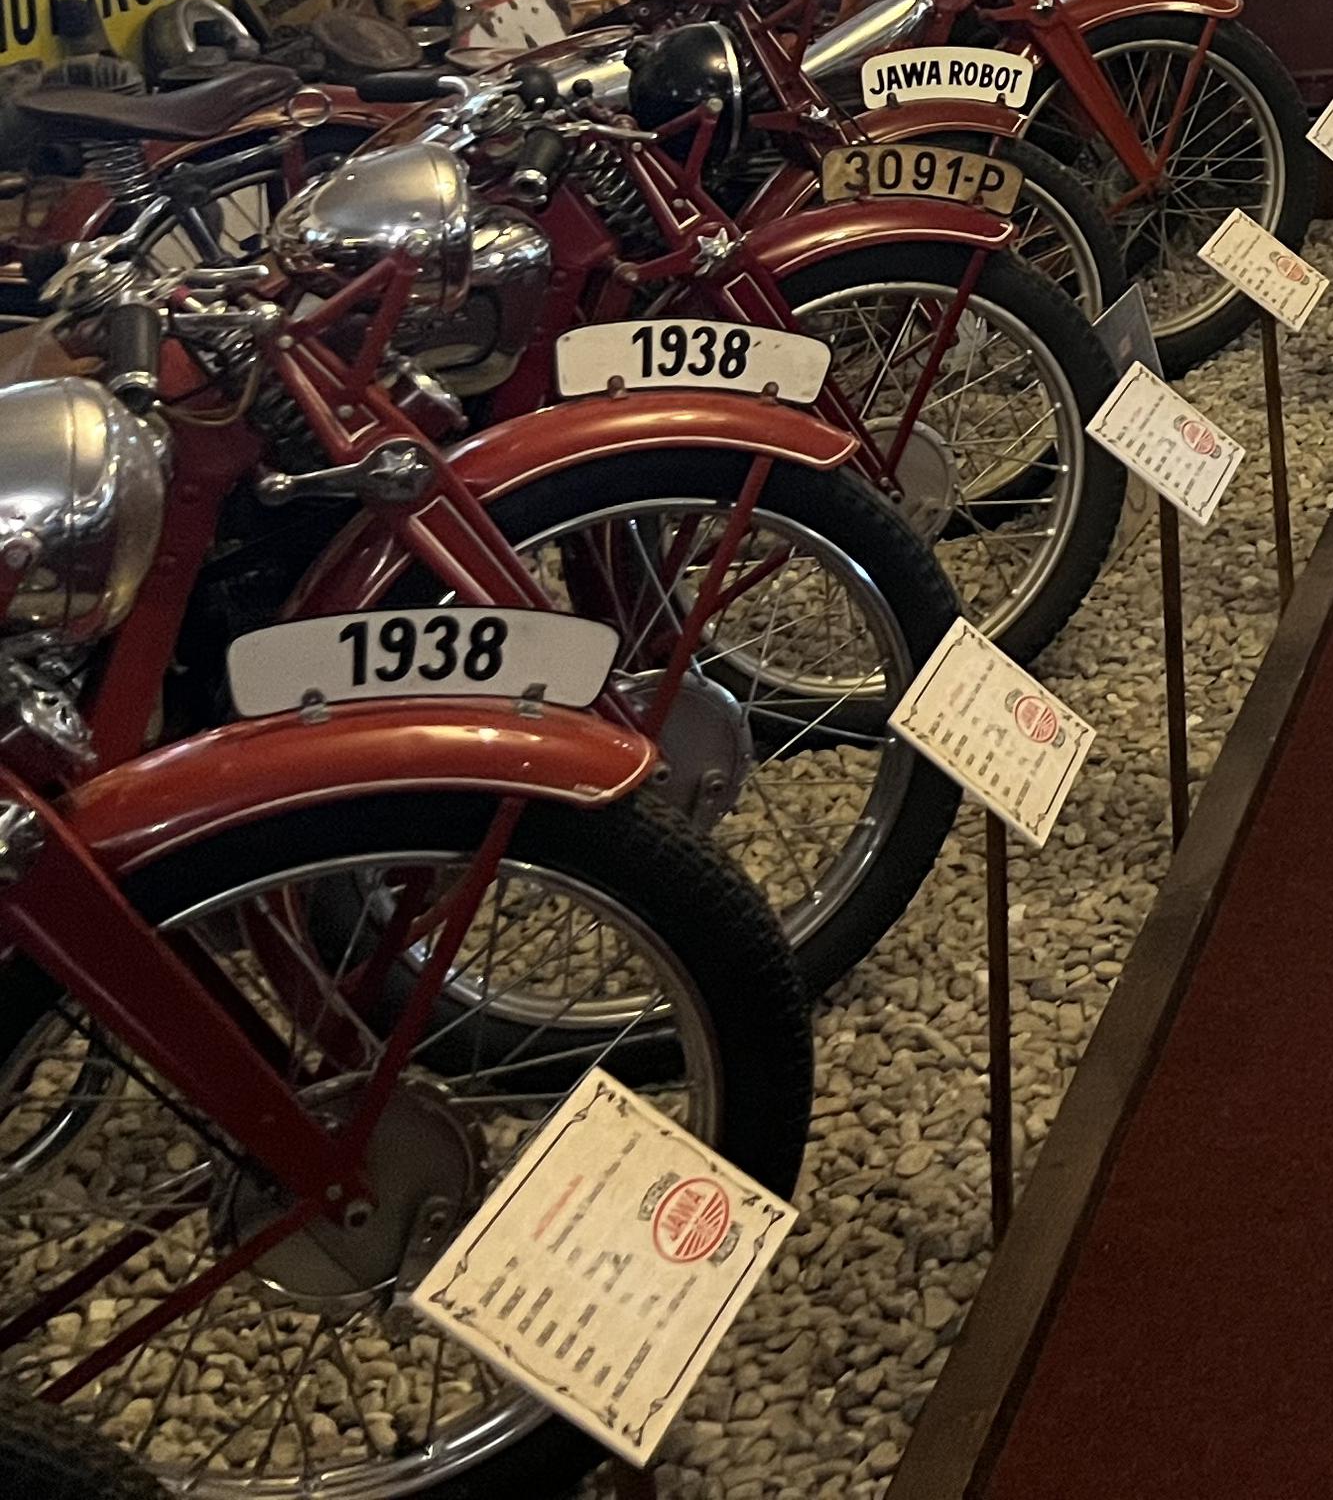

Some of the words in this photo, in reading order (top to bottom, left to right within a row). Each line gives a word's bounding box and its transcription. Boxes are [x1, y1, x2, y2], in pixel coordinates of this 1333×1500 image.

[869, 60, 942, 95] JAWA
[948, 60, 1023, 94] ROBOT
[844, 149, 1006, 195] 3091-P
[631, 325, 750, 380] 1938
[338, 614, 509, 688] 1938
